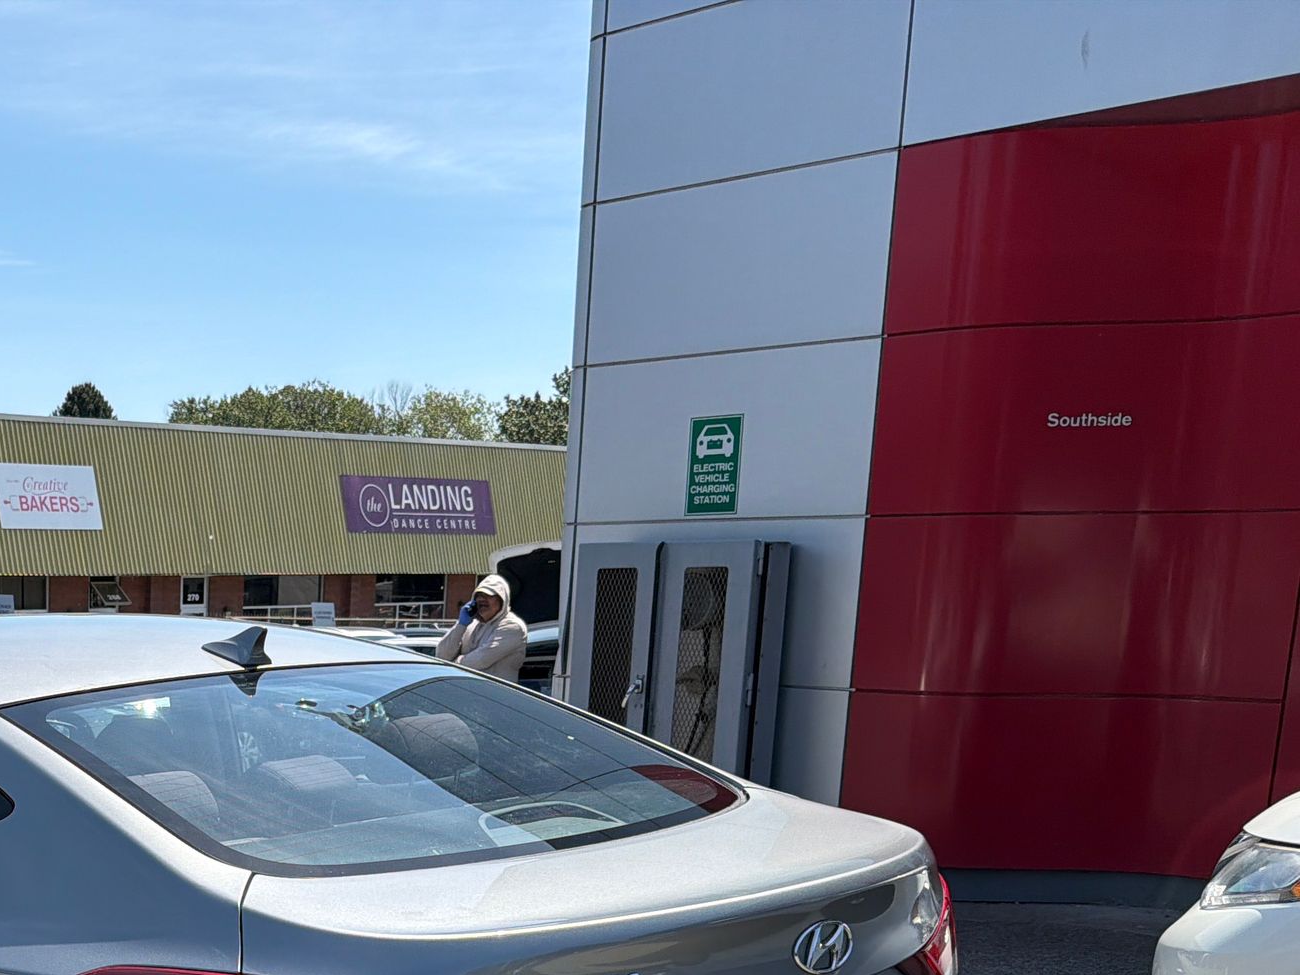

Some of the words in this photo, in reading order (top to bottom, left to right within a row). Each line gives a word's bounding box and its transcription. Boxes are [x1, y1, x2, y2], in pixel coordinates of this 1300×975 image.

[1047, 412, 1132, 427] Southside
[693, 462, 734, 473] ELECTRIC
[694, 473, 730, 483] VEHICLE
[22, 476, 69, 493] Creative
[690, 484, 736, 494] CHARGING
[366, 495, 383, 513] the
[388, 483, 474, 511] LANDING
[693, 495, 730, 505] STATION
[19, 495, 80, 513] BAKERS
[392, 518, 430, 529] DANCE
[435, 519, 477, 530] CENTRE
[187, 593, 200, 602] 270
